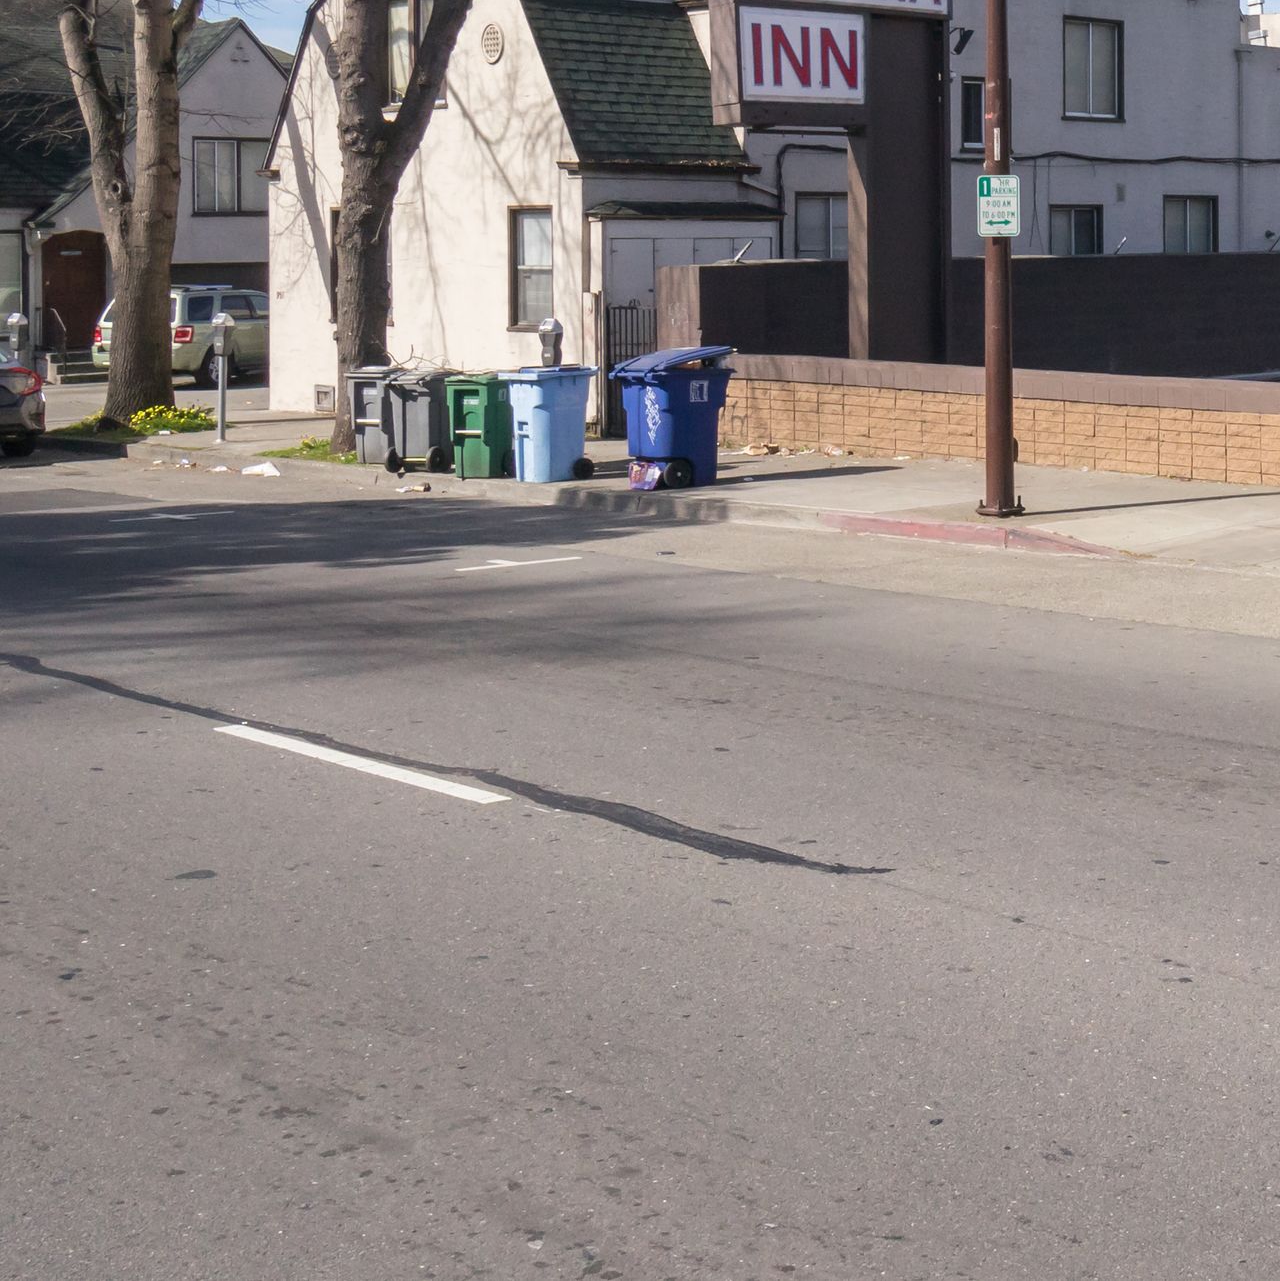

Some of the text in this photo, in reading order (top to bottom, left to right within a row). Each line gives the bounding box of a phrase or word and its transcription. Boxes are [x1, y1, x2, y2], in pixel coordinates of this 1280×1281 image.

[751, 22, 859, 89] INN
[999, 179, 1010, 187] HR
[982, 180, 988, 195] 1
[992, 187, 1017, 195] PARKING
[986, 200, 1011, 208] 9:00 AM
[982, 210, 1016, 219] TO 6:00 PM
